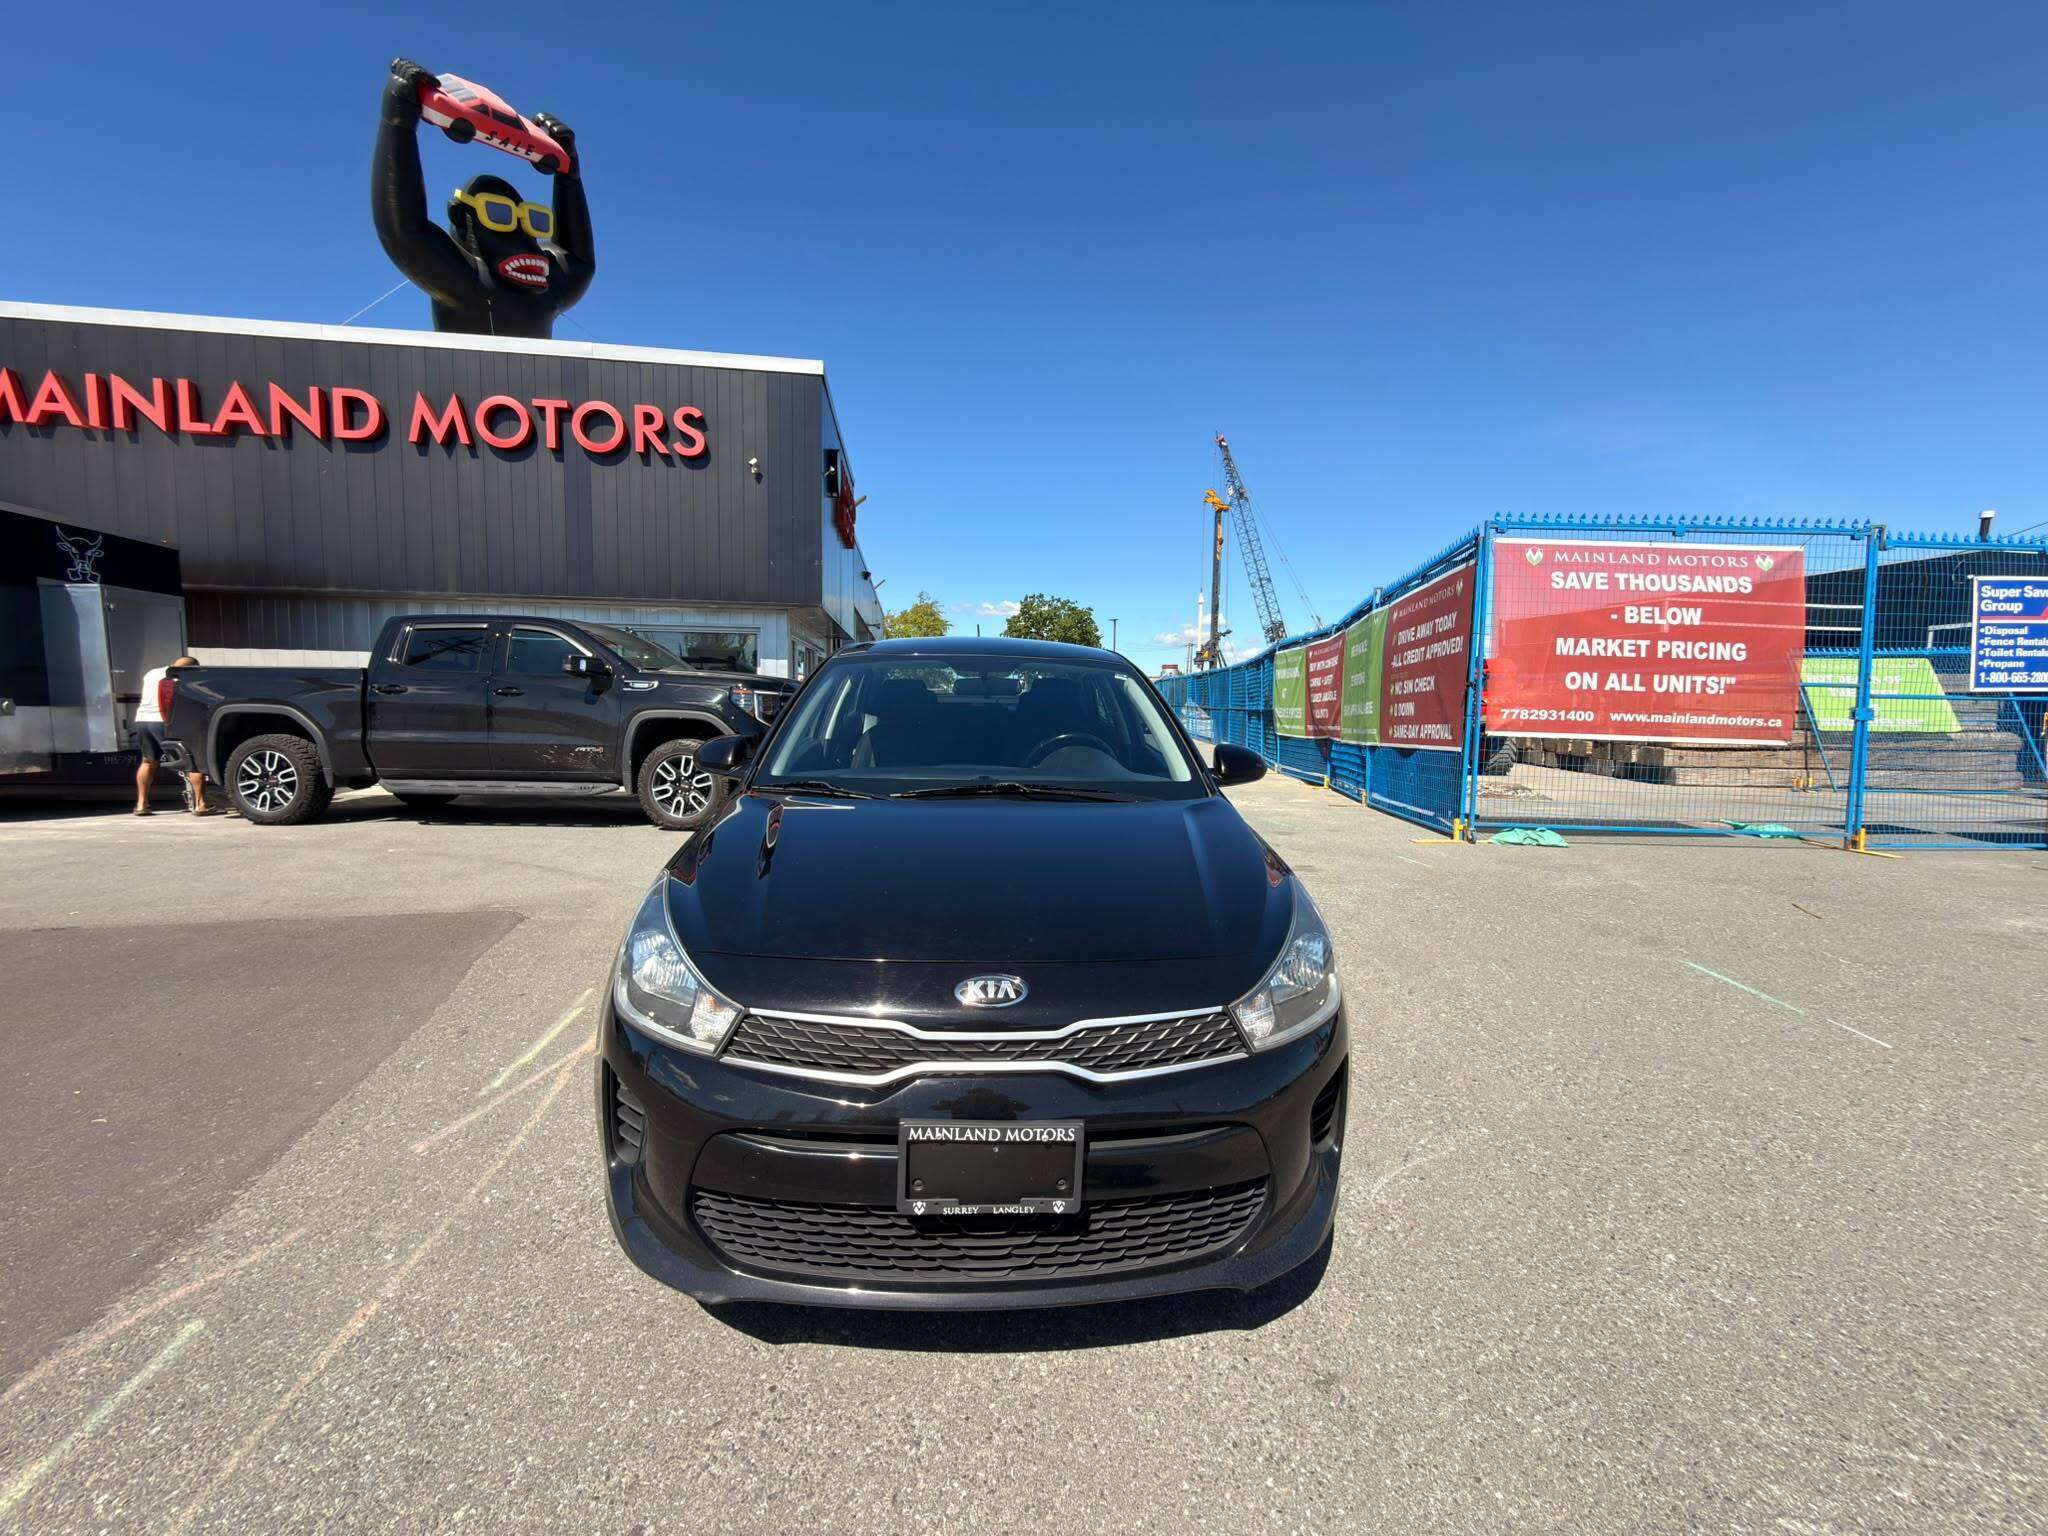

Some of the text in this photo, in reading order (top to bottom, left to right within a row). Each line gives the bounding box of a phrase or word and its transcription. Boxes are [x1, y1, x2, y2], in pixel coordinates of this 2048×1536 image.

[486, 131, 536, 156] SALE
[408, 391, 708, 458] MOTORS
[1554, 551, 1748, 568] MAINLAND MOTORS
[1551, 571, 1753, 593] SAVE THOUSANDS
[1981, 585, 2048, 600] Super Sav
[1981, 599, 2023, 614] Group
[1624, 606, 1702, 625] BELOW
[1397, 611, 1457, 645] DRIVE AWAY TODAY
[1985, 626, 2028, 636] Disposal
[1403, 646, 1425, 665] CREDIT
[1425, 635, 1464, 660] APPROVED!
[1555, 637, 1747, 661] MARKET PRICING
[1984, 637, 2015, 646] Fence
[1983, 648, 2014, 657] Toilet
[1984, 659, 2025, 670] Propane
[1414, 676, 1435, 693] CHECK
[1565, 672, 1736, 695] ON ALL UNITS!"
[1500, 708, 1783, 728] 7782931400 www.mainlandmotors.ca
[1420, 723, 1452, 740] APPROVAL
[967, 980, 1016, 999] KIA
[908, 1127, 1075, 1142] MAINLAND MOTORS
[943, 1206, 1036, 1215] SURREY LANGLEY
